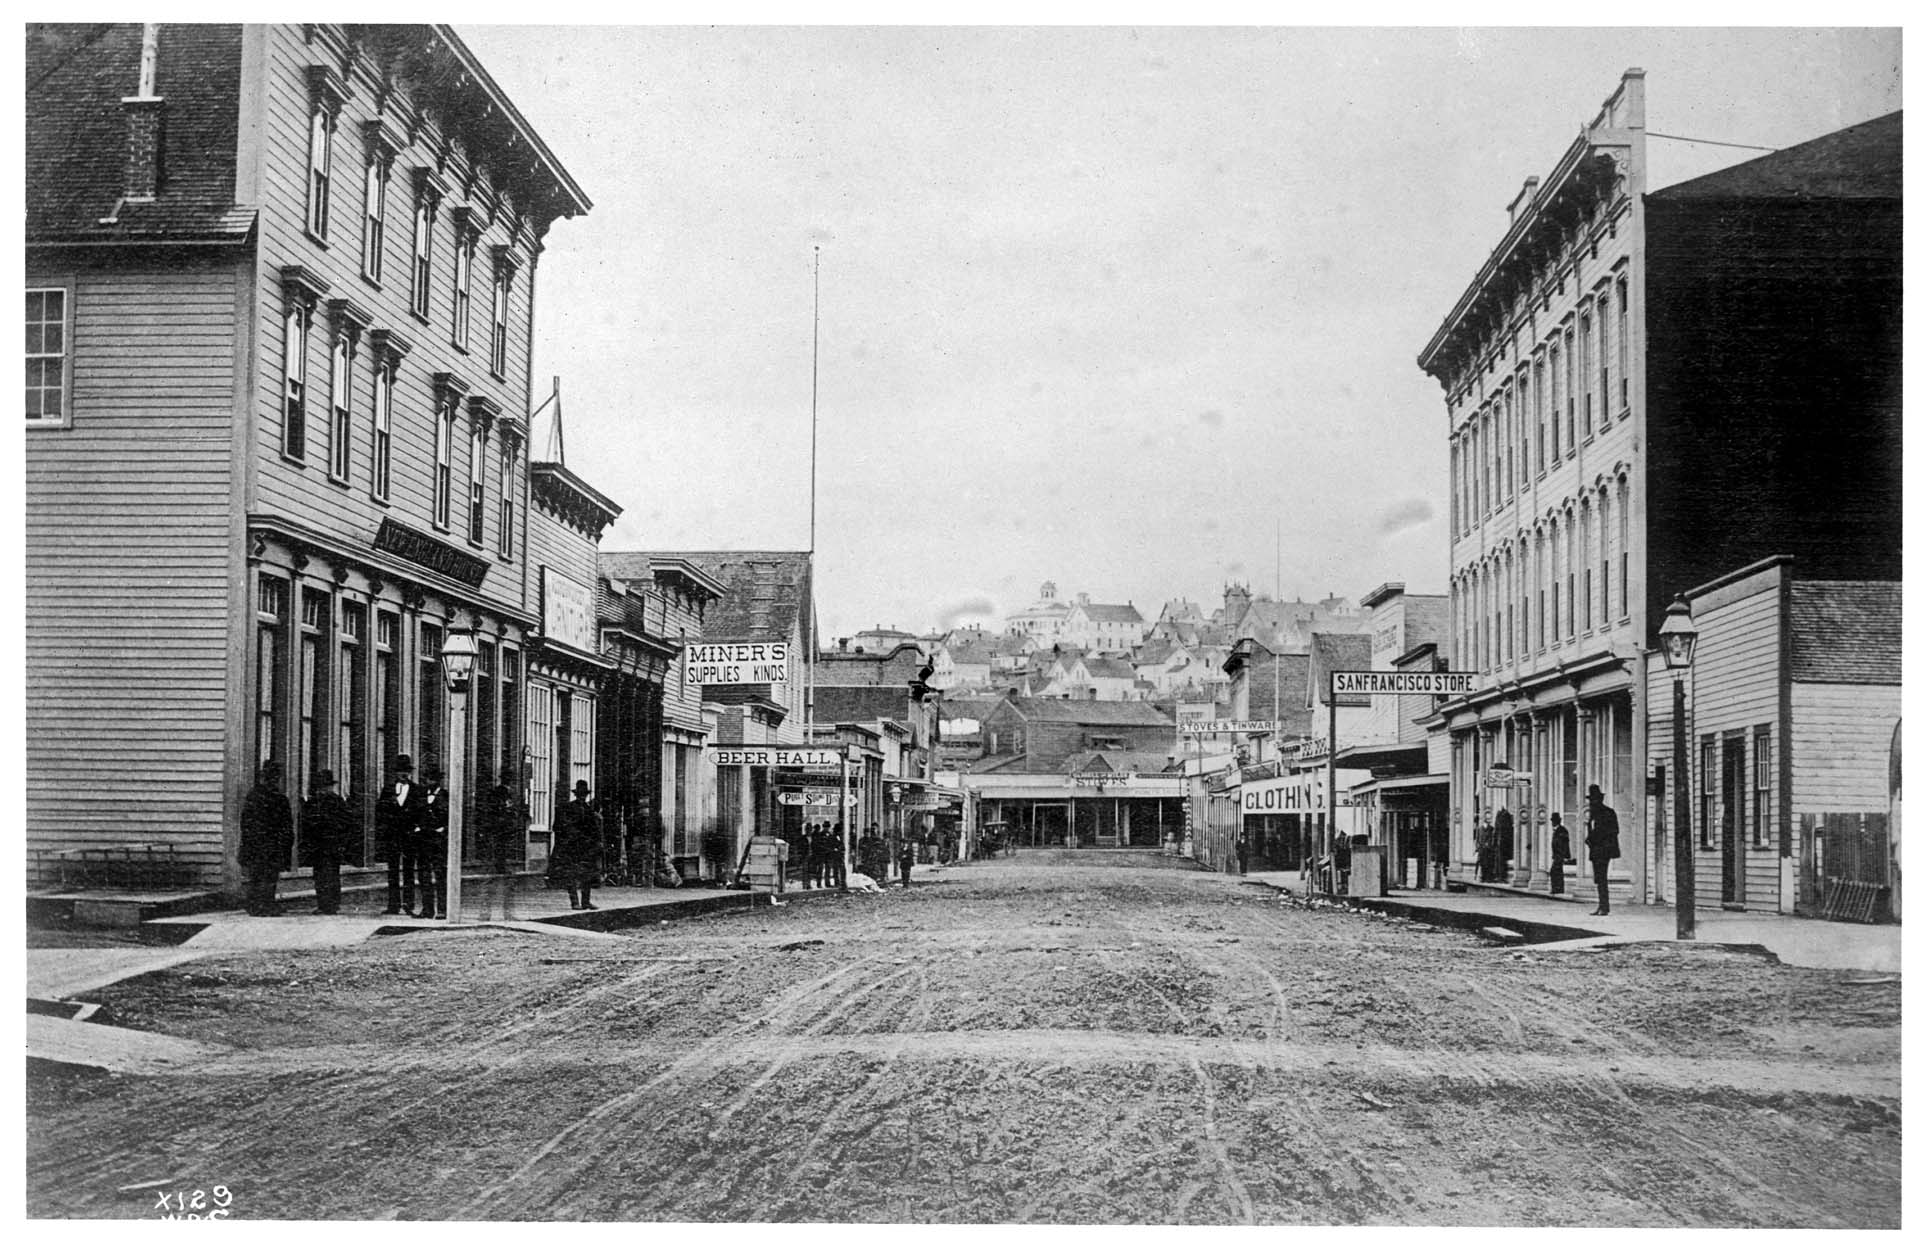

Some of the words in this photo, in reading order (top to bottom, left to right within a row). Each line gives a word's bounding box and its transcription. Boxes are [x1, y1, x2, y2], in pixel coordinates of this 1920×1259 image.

[689, 644, 785, 663] MINER'S
[688, 666, 740, 683] SUPPLIES
[753, 664, 787, 682] KINDS.
[1435, 675, 1478, 692] STORE.
[1179, 721, 1218, 731] STOVES
[717, 752, 770, 764] BEER
